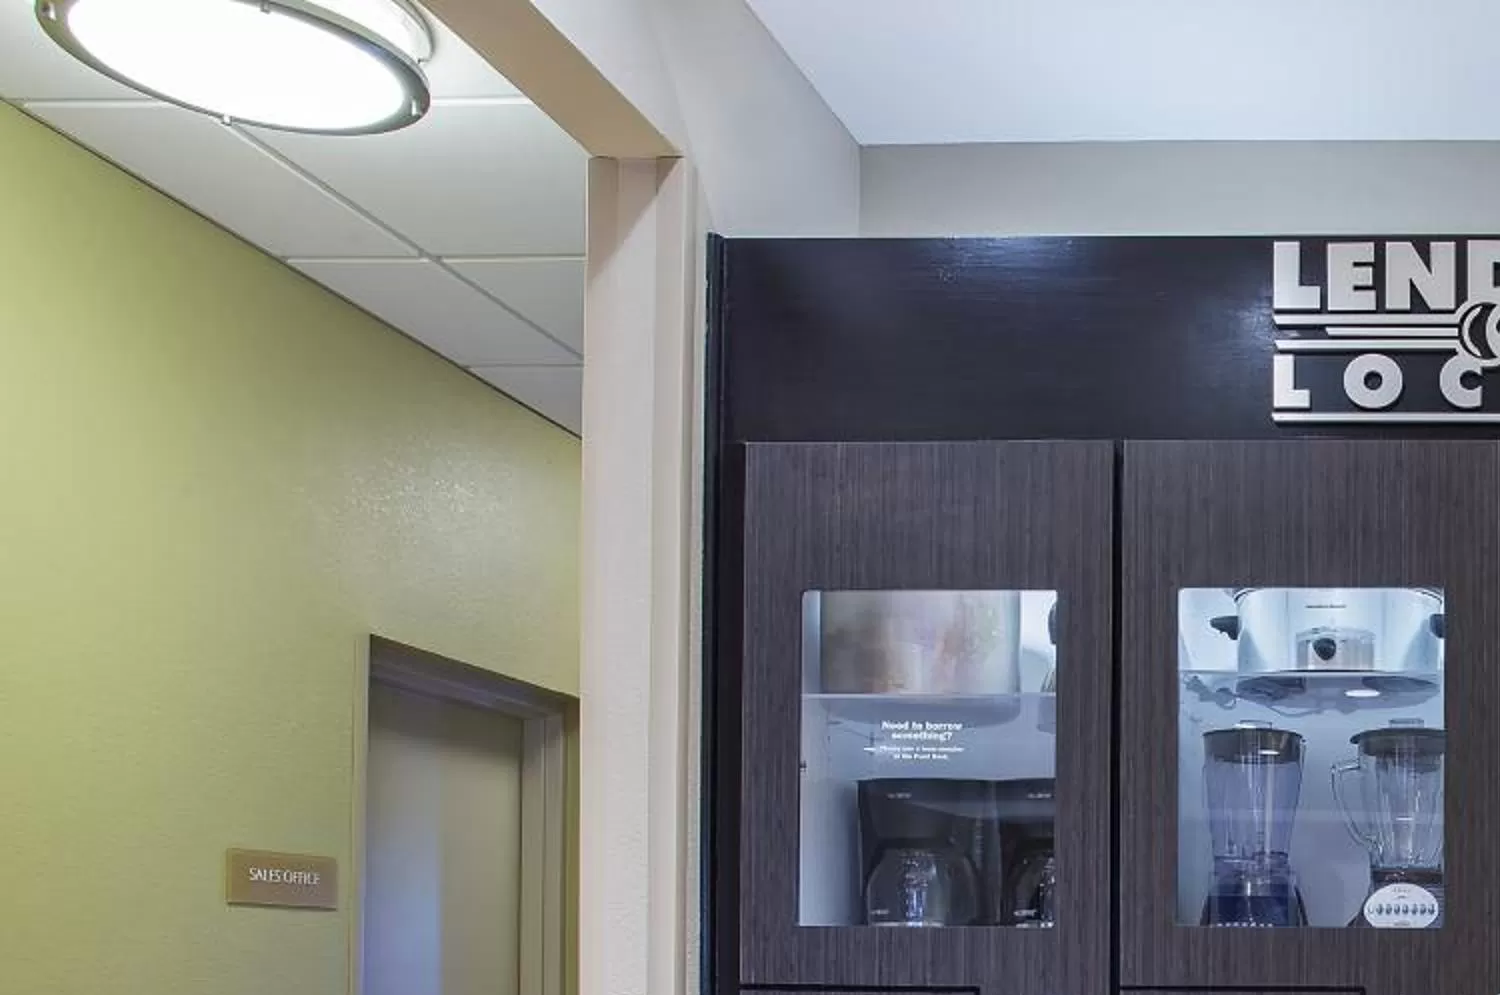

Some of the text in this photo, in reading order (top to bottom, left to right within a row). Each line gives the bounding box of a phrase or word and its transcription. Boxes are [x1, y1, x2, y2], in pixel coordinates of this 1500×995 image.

[881, 721, 963, 731] Need to borrow
[891, 732, 953, 742] something?
[248, 867, 321, 886] SALES OFFICE
